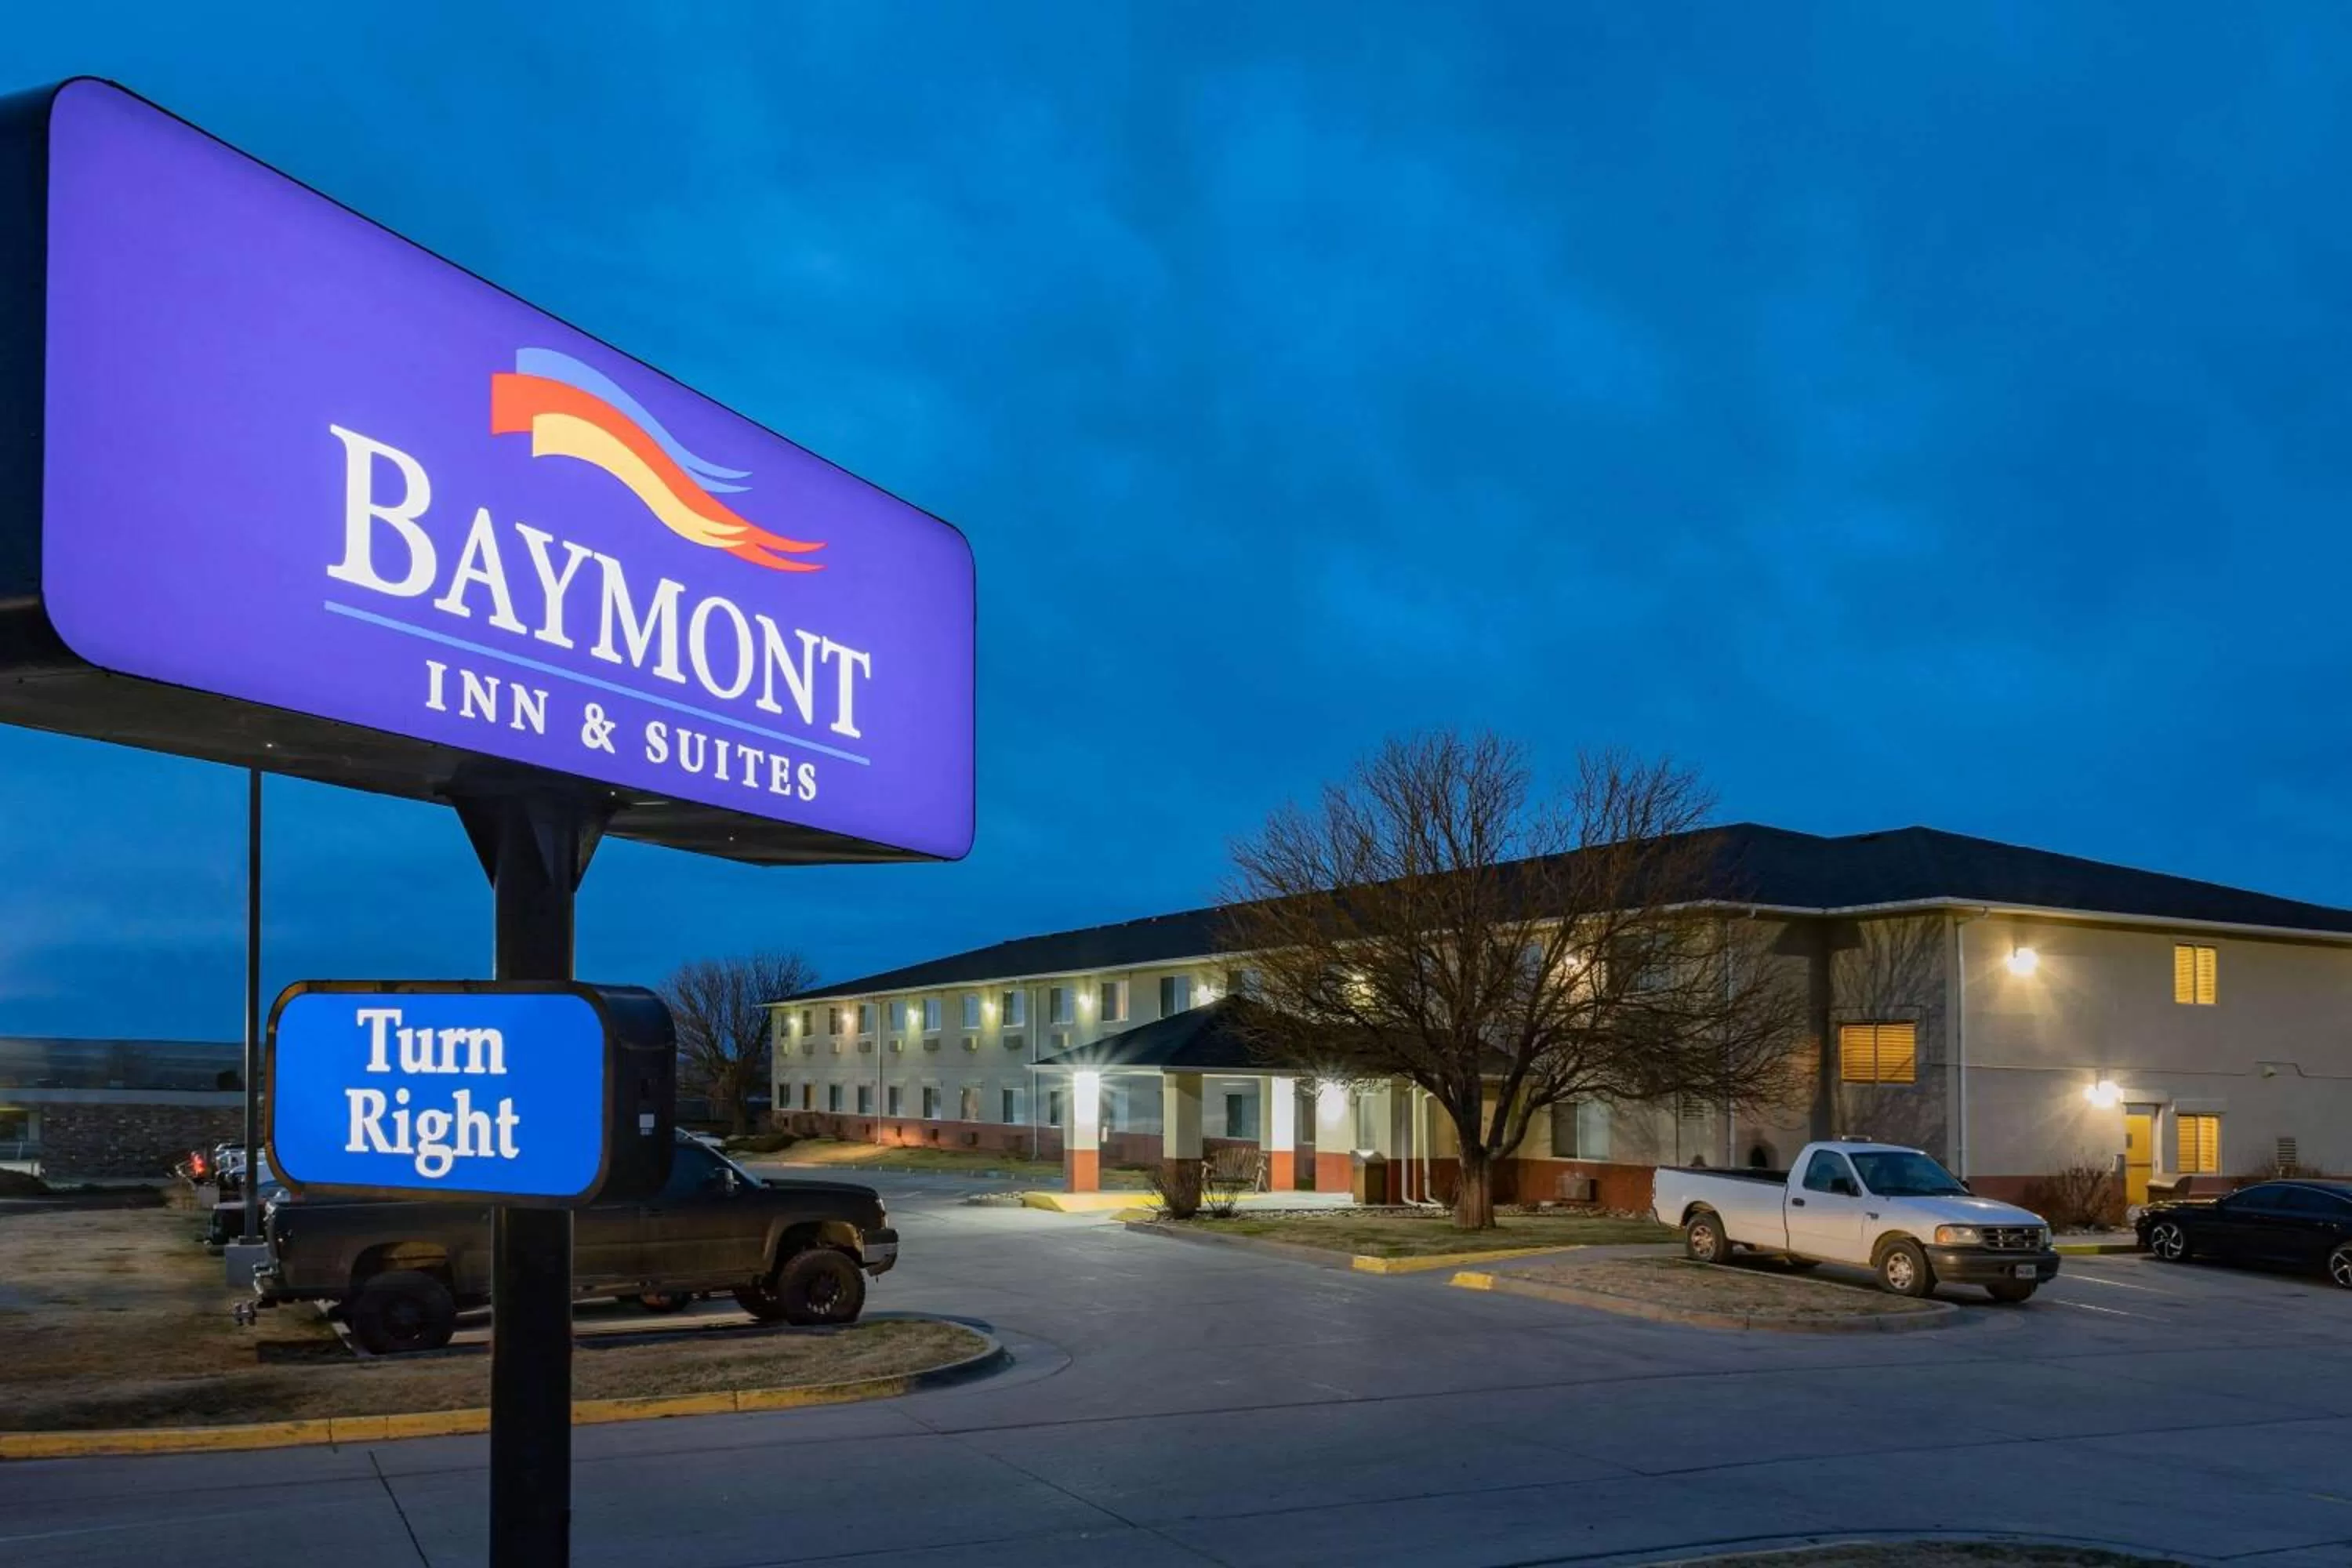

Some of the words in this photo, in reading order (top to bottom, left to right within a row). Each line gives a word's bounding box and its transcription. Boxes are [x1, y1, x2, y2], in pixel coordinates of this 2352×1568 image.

[326, 423, 871, 739] BAYMONT
[426, 659, 549, 735] INN
[581, 702, 615, 753] &
[645, 720, 816, 801] SUITES
[357, 1008, 507, 1075] Turn
[345, 1087, 520, 1178] Right
